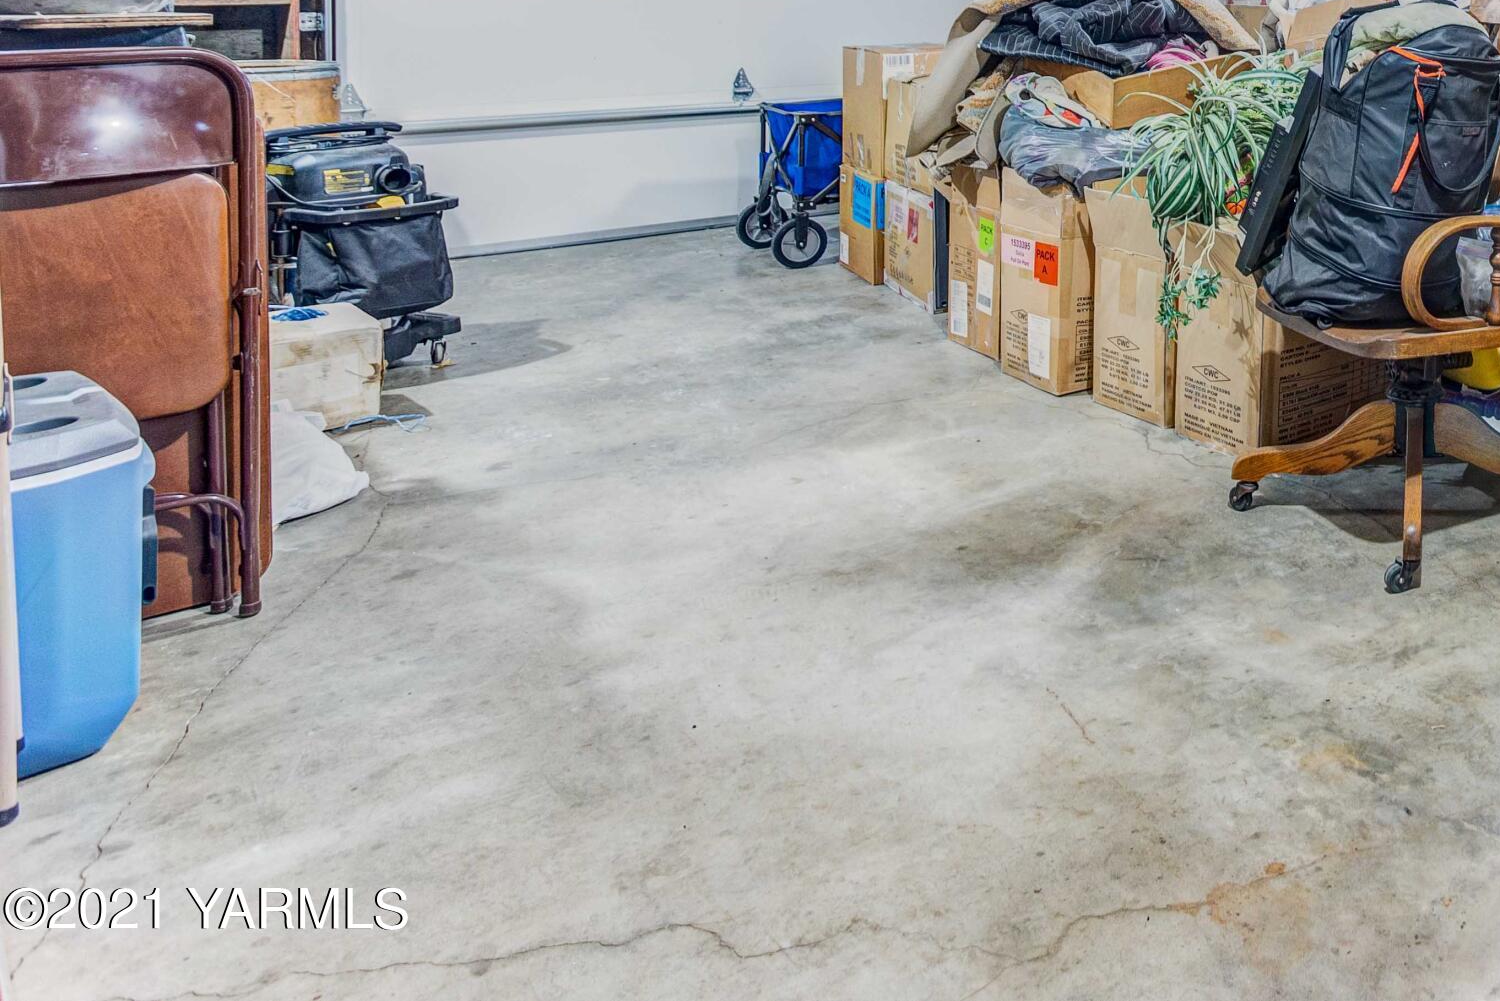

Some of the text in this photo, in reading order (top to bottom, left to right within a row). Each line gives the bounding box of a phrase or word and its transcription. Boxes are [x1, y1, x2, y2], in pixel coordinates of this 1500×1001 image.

[1036, 250, 1055, 262] PACK
[1042, 264, 1048, 275] A
[1117, 339, 1130, 348] CWC
[1204, 368, 1219, 379] CWC
[1185, 382, 1207, 393] COSTCO
[1184, 412, 1199, 421] MADE
[1210, 422, 1234, 434] VIETNAM
[1213, 435, 1236, 448] VIETNAM
[1220, 433, 1244, 445] VIETNAM
